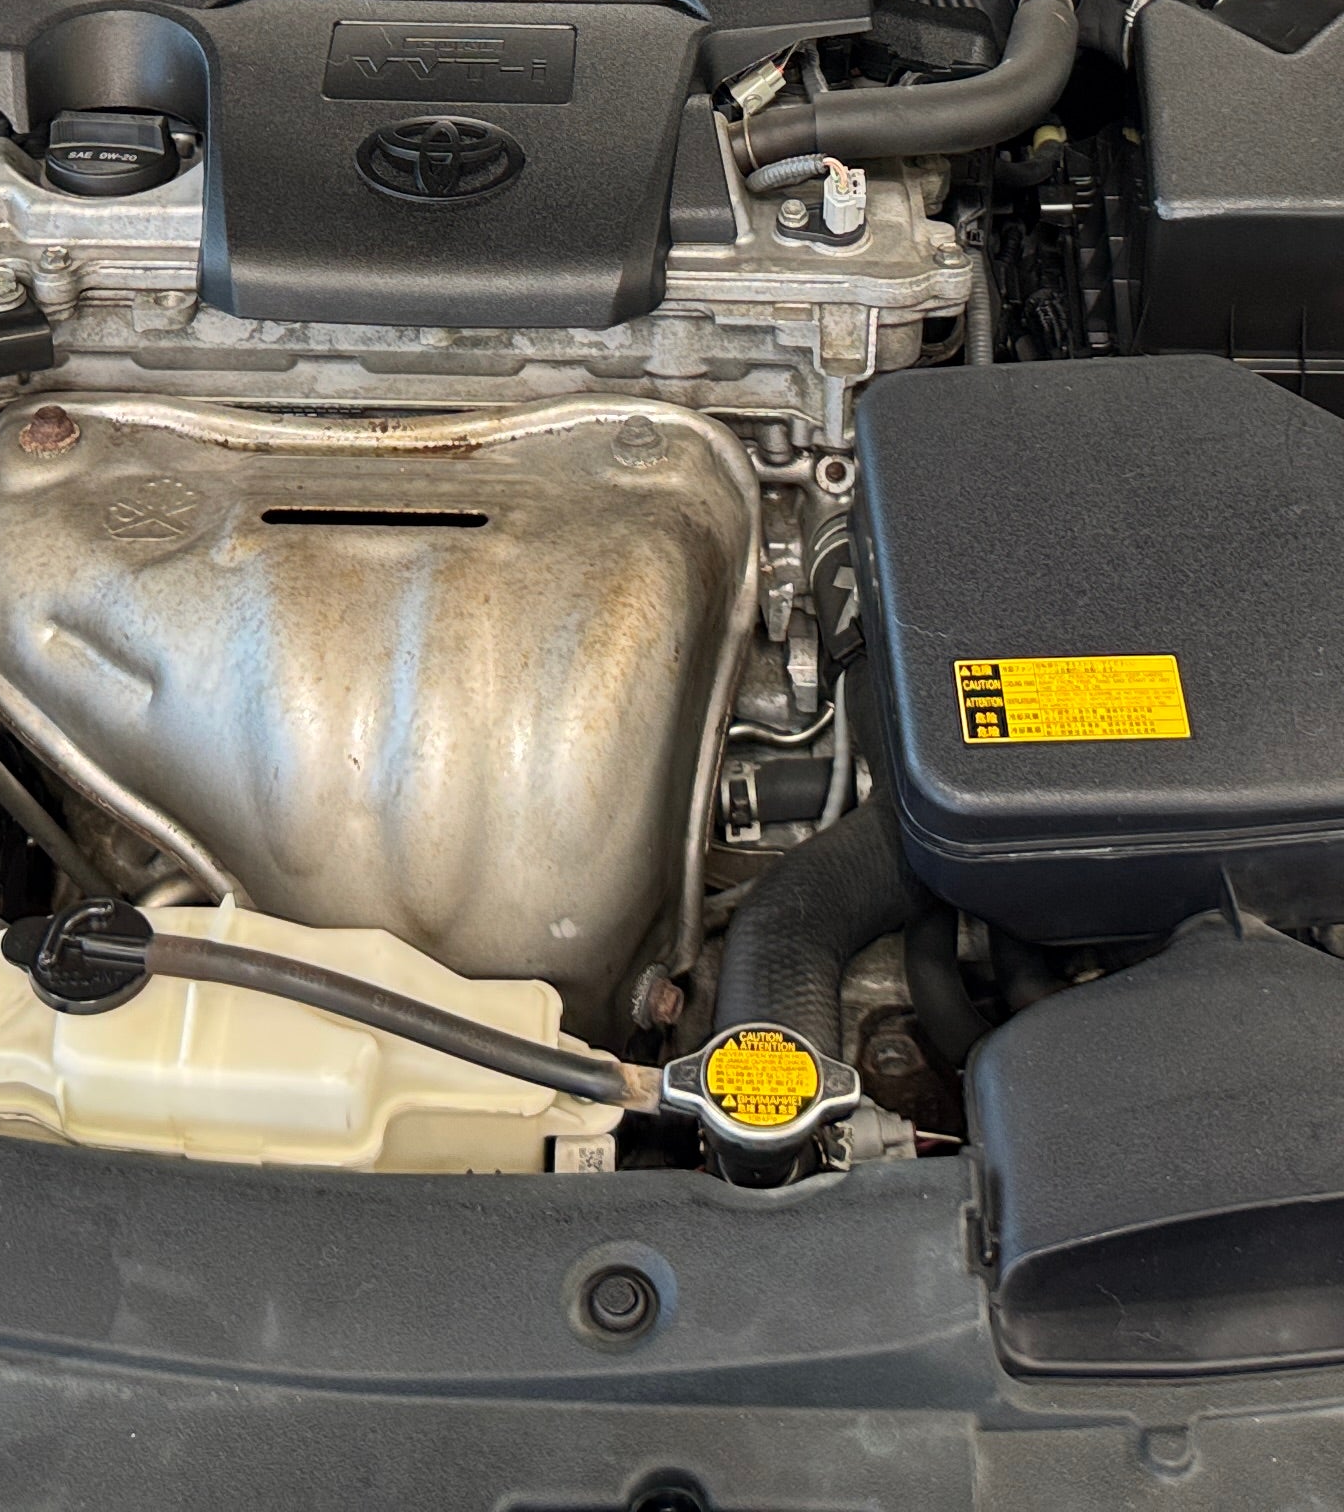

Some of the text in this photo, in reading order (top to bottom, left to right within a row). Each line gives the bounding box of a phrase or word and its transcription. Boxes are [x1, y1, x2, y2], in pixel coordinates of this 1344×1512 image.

[352, 56, 547, 82] VVT-i
[67, 150, 138, 162] SAE 0W-20
[963, 679, 1001, 691] CAUTION
[966, 696, 1004, 708] ATTENTION
[739, 1031, 783, 1043] CAUTION
[739, 1041, 796, 1052] ATTENTION
